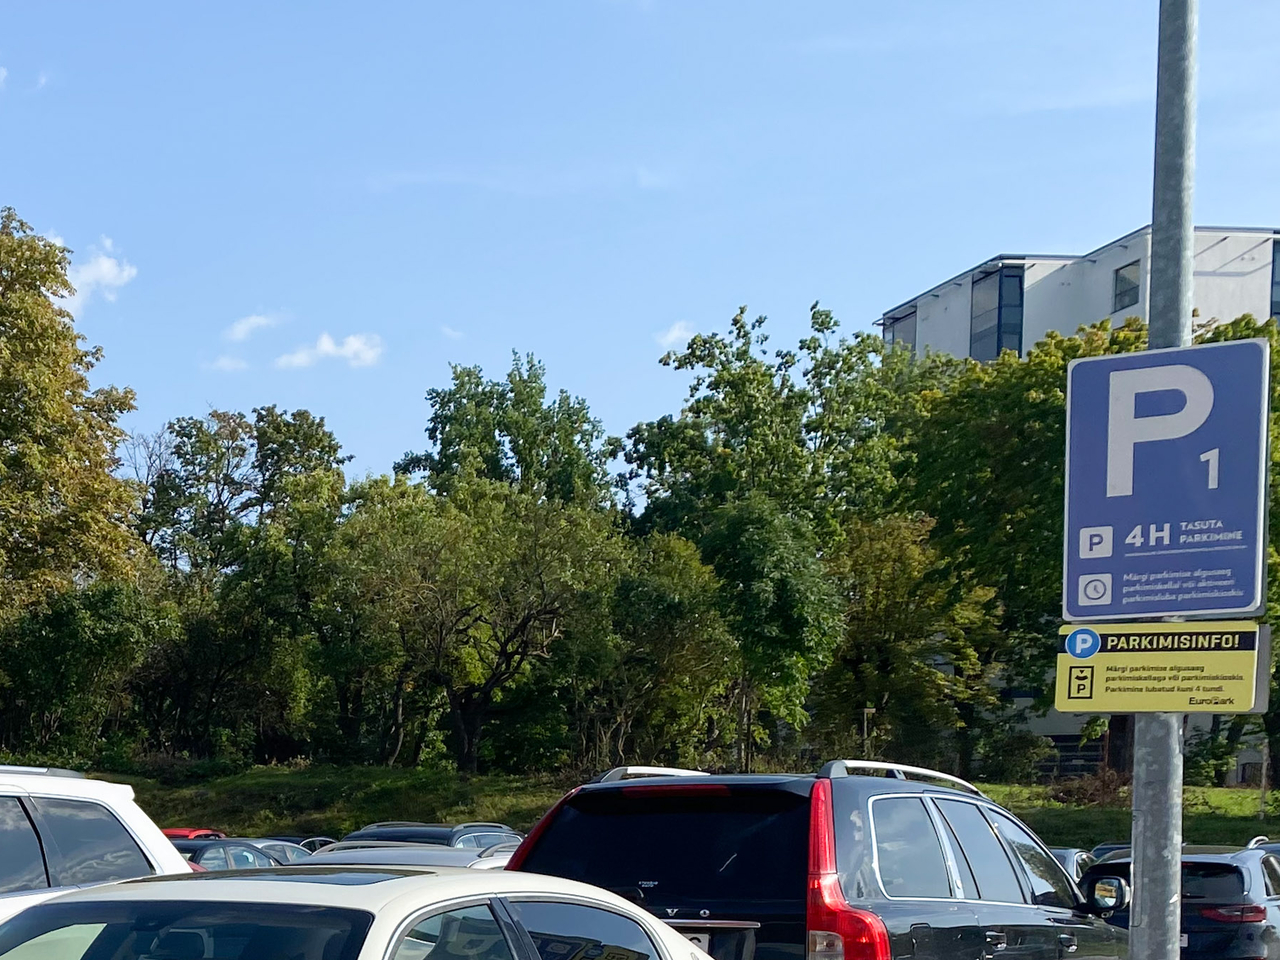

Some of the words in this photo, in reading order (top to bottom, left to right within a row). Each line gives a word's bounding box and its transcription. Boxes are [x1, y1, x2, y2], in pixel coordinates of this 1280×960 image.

[1106, 364, 1214, 498] P
[1199, 447, 1220, 490] 1
[1180, 519, 1224, 531] TASUTA
[1179, 531, 1243, 544] PARKIMINE
[1107, 634, 1240, 650] PARKIMISINFO!
